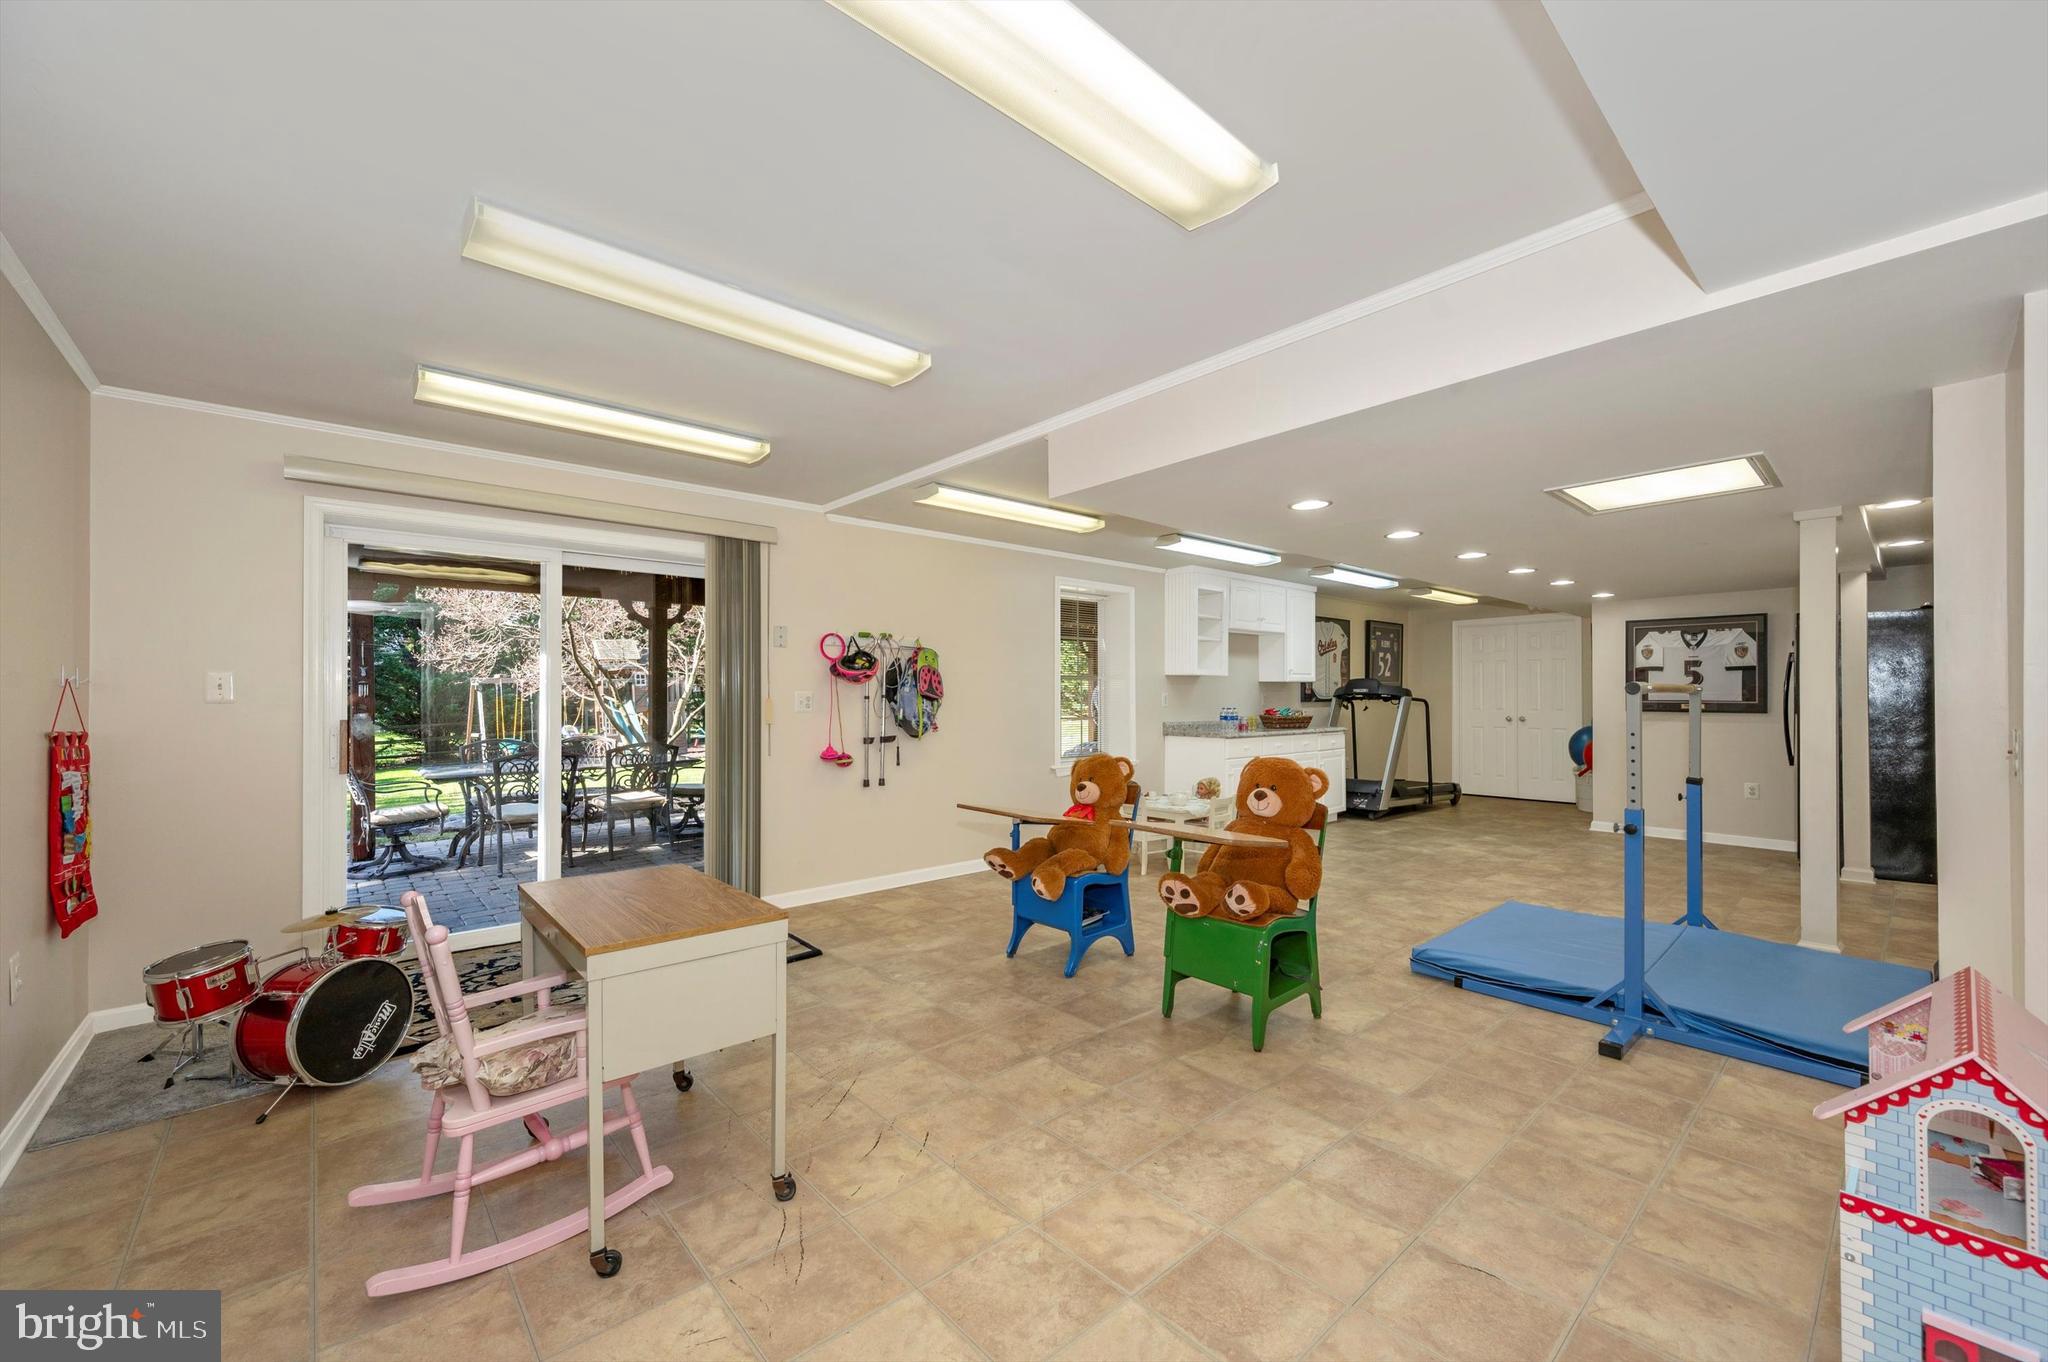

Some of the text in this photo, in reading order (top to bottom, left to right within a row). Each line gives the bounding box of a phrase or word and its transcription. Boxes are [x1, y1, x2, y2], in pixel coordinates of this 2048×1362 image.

[1377, 652, 1392, 677] 52
[1684, 660, 1704, 685] 5
[353, 1003, 393, 1057] Music Alley
